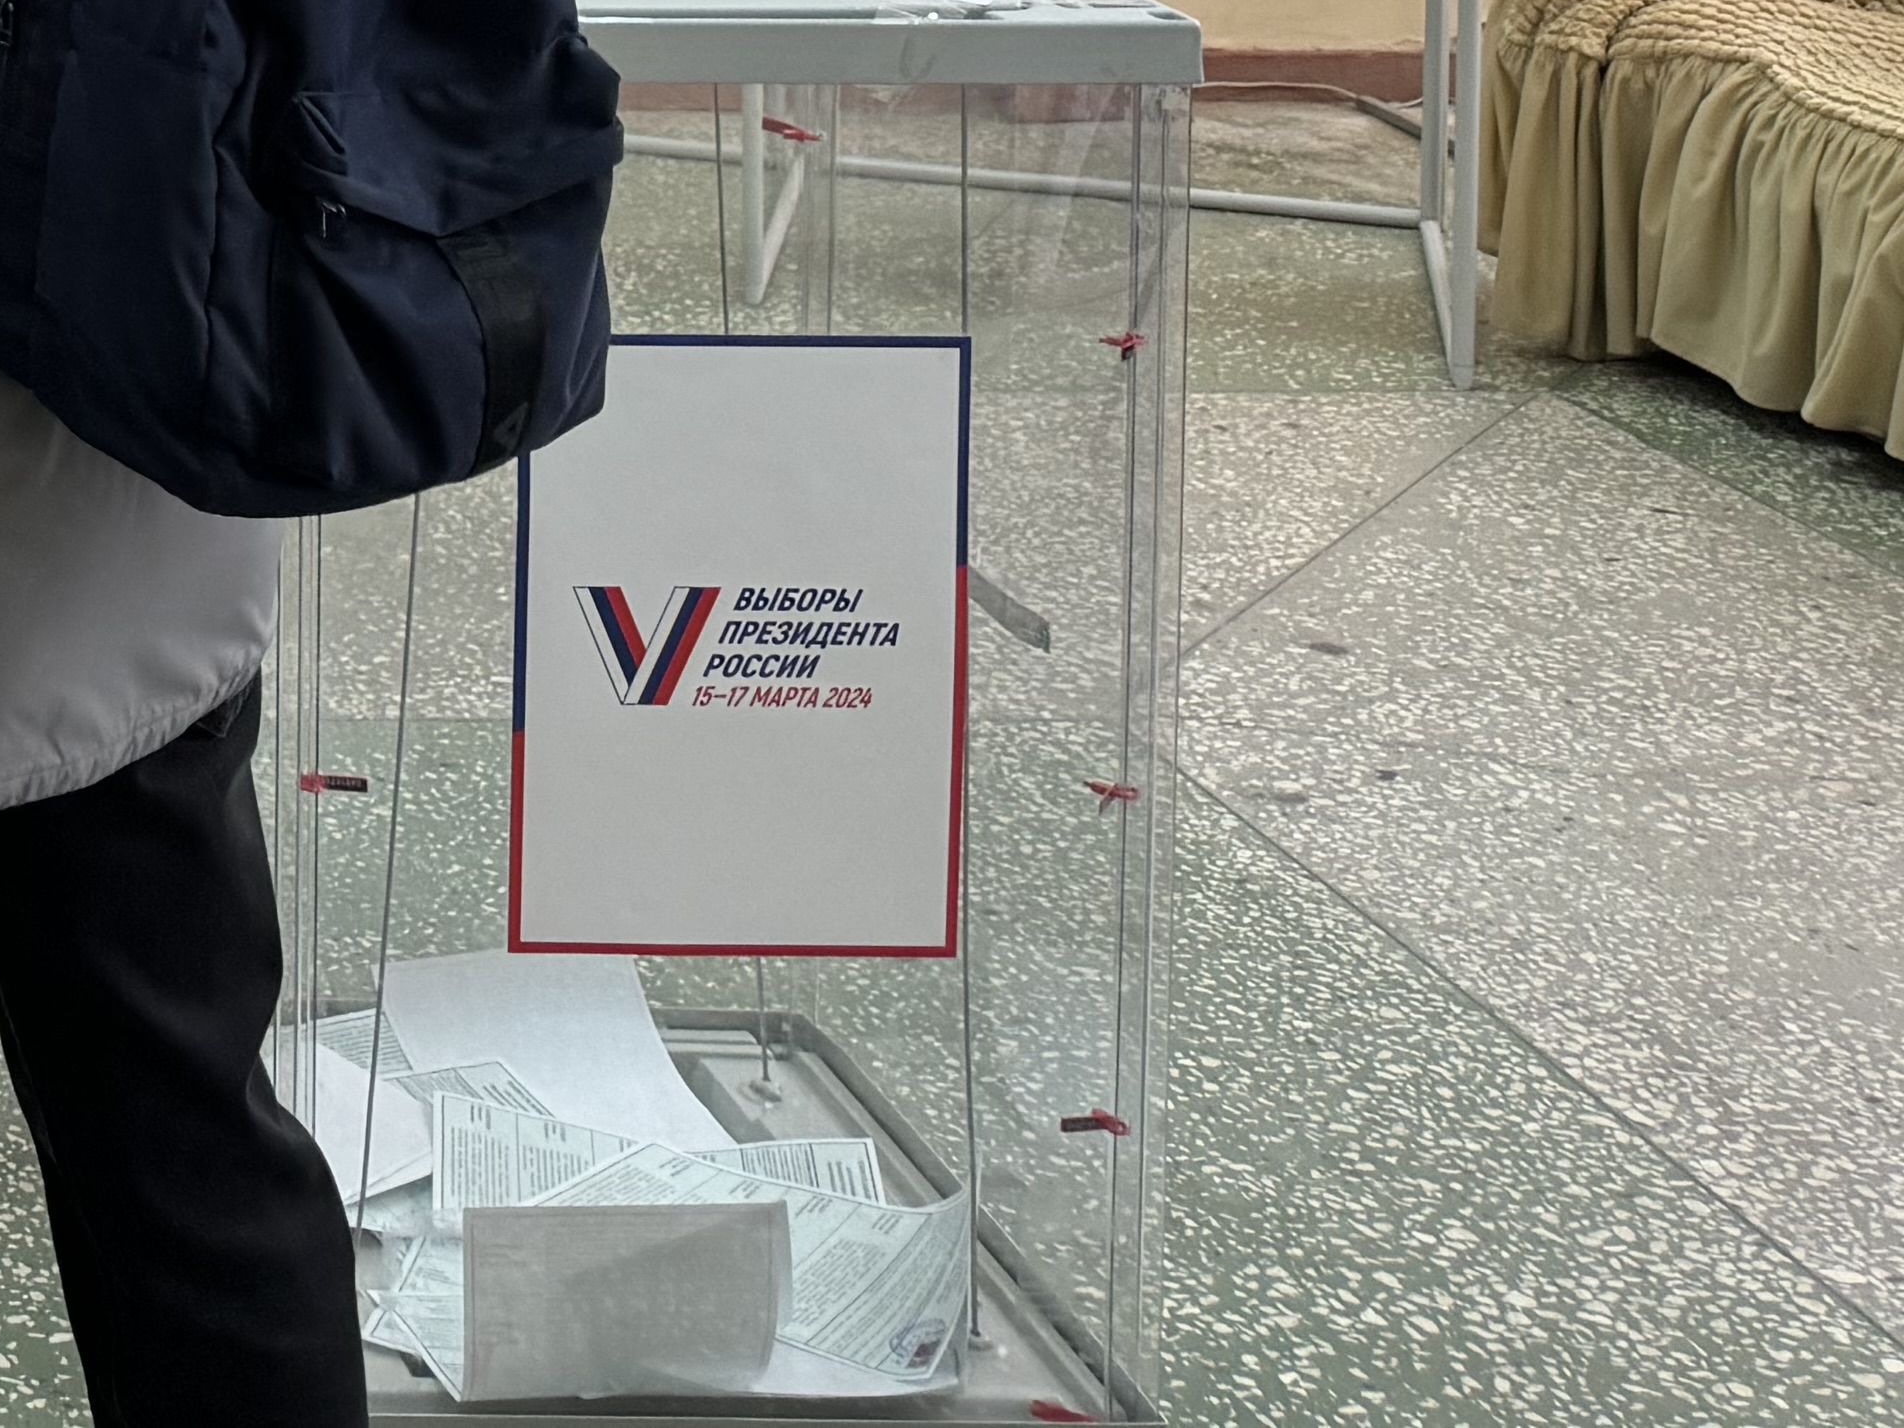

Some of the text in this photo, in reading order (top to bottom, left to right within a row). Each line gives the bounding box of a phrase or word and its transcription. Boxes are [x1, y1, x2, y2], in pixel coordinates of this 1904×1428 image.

[733, 588, 864, 613] ВЫБОРЫ
[718, 620, 900, 649] ПРЕЗИДЕНТА
[702, 654, 820, 678] РОССИИ
[749, 687, 818, 708] МАРТА
[822, 687, 873, 709] 2024
